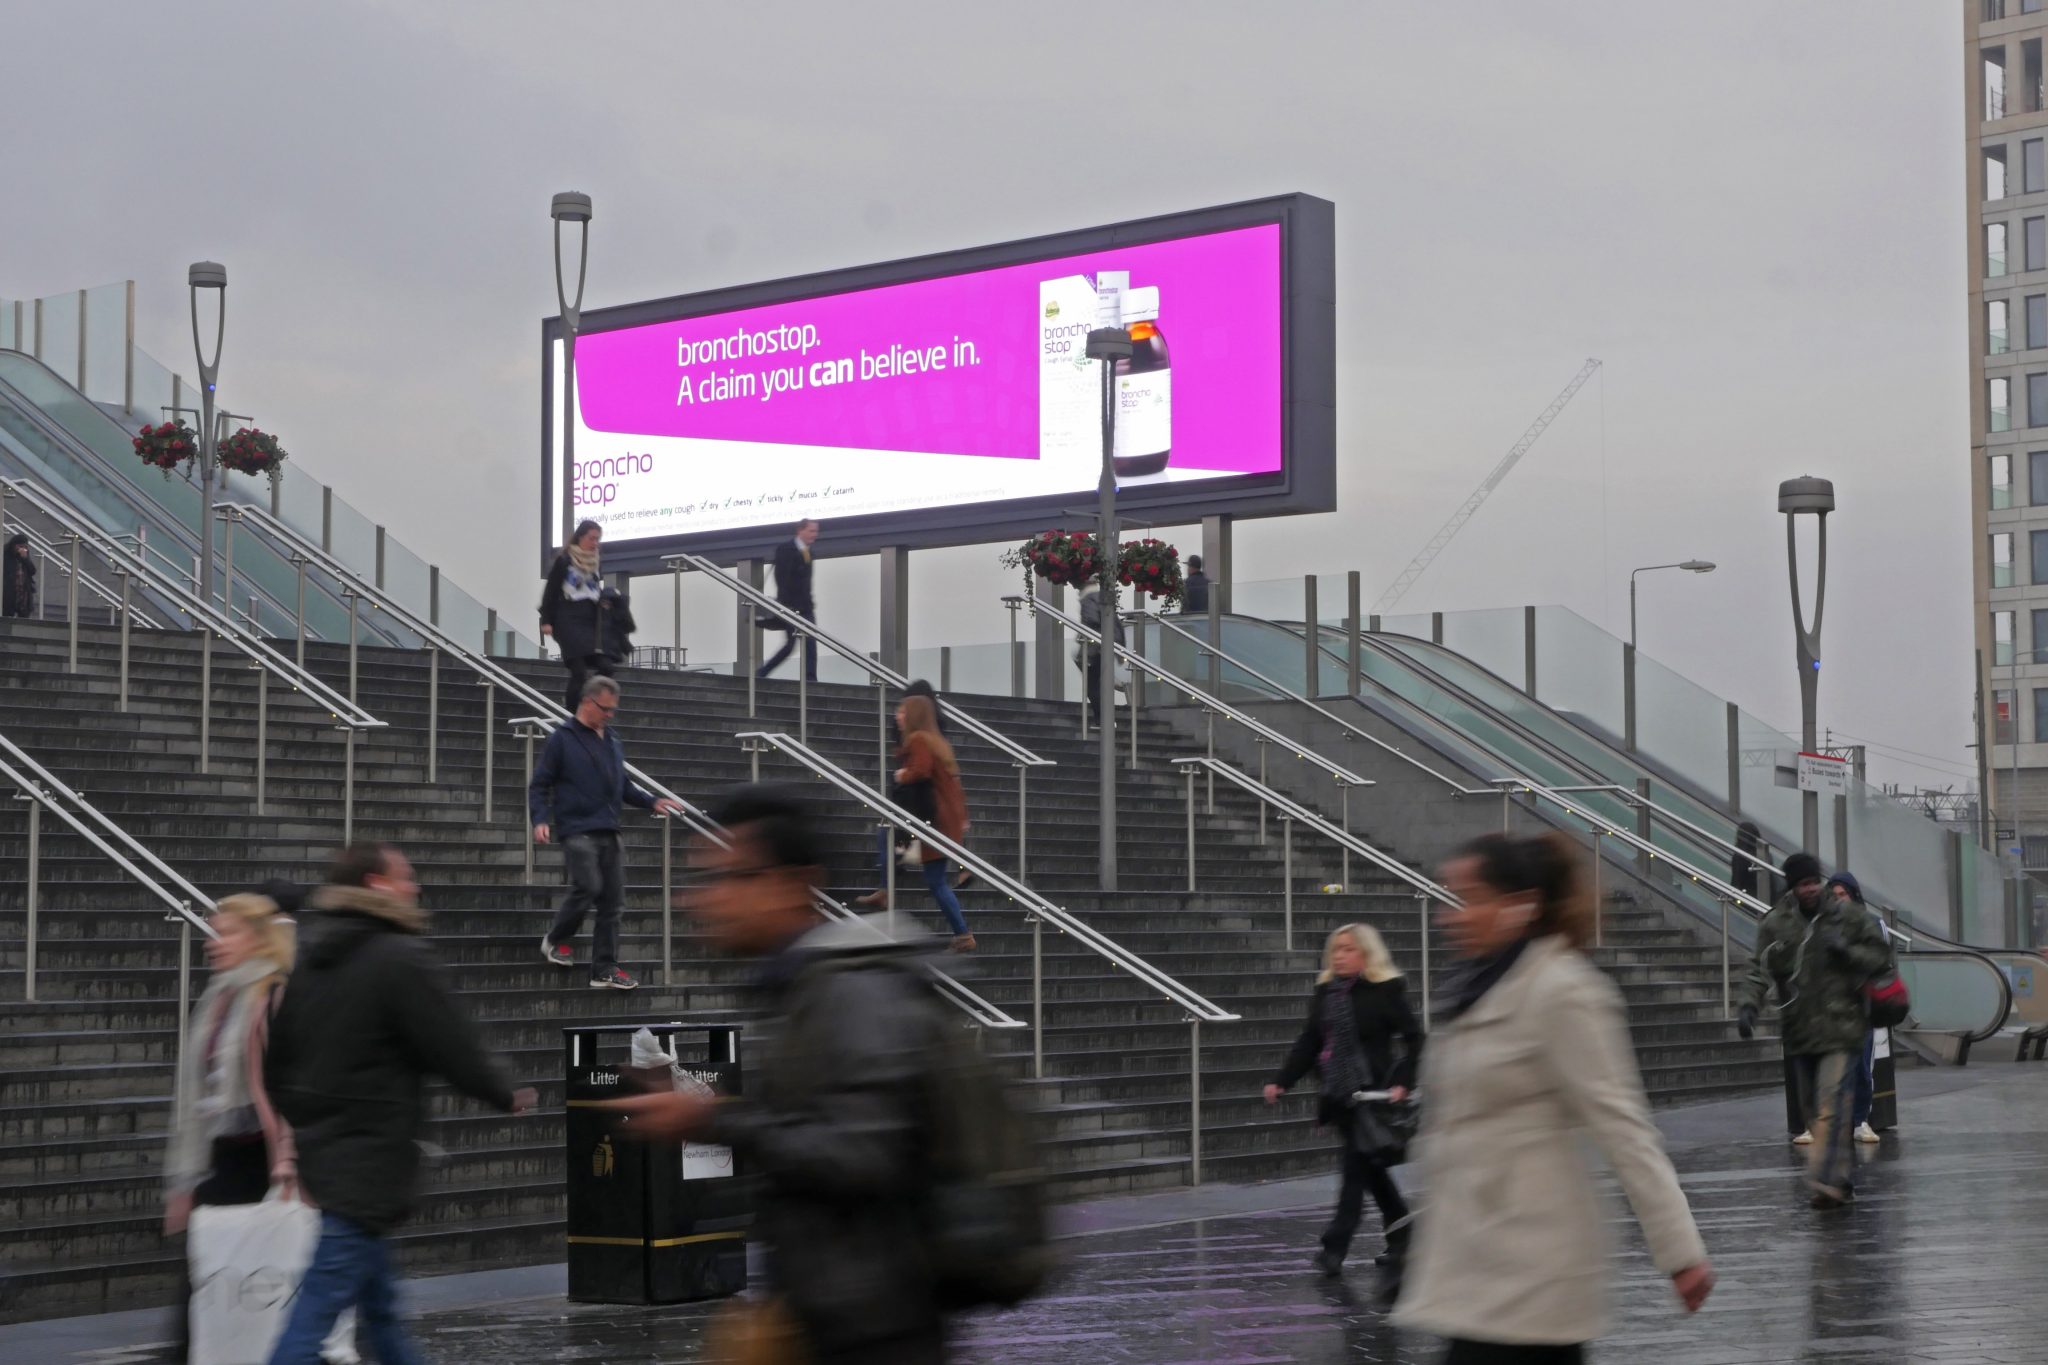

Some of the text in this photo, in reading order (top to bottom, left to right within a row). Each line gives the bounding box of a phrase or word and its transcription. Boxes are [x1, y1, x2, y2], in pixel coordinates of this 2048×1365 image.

[1044, 322, 1092, 340] broncho
[678, 323, 821, 367] bronchostop.
[1044, 340, 1071, 354] stop
[677, 335, 981, 406] A claim you can believe in.
[610, 509, 626, 521] used
[627, 508, 635, 519] to
[636, 506, 658, 518] relieve
[659, 506, 673, 517] any
[674, 503, 696, 515] cough
[709, 501, 719, 511] dry
[732, 496, 753, 507] chesty
[798, 491, 818, 499] mucus
[590, 1071, 620, 1085] Litter
[689, 1070, 719, 1083] itter
